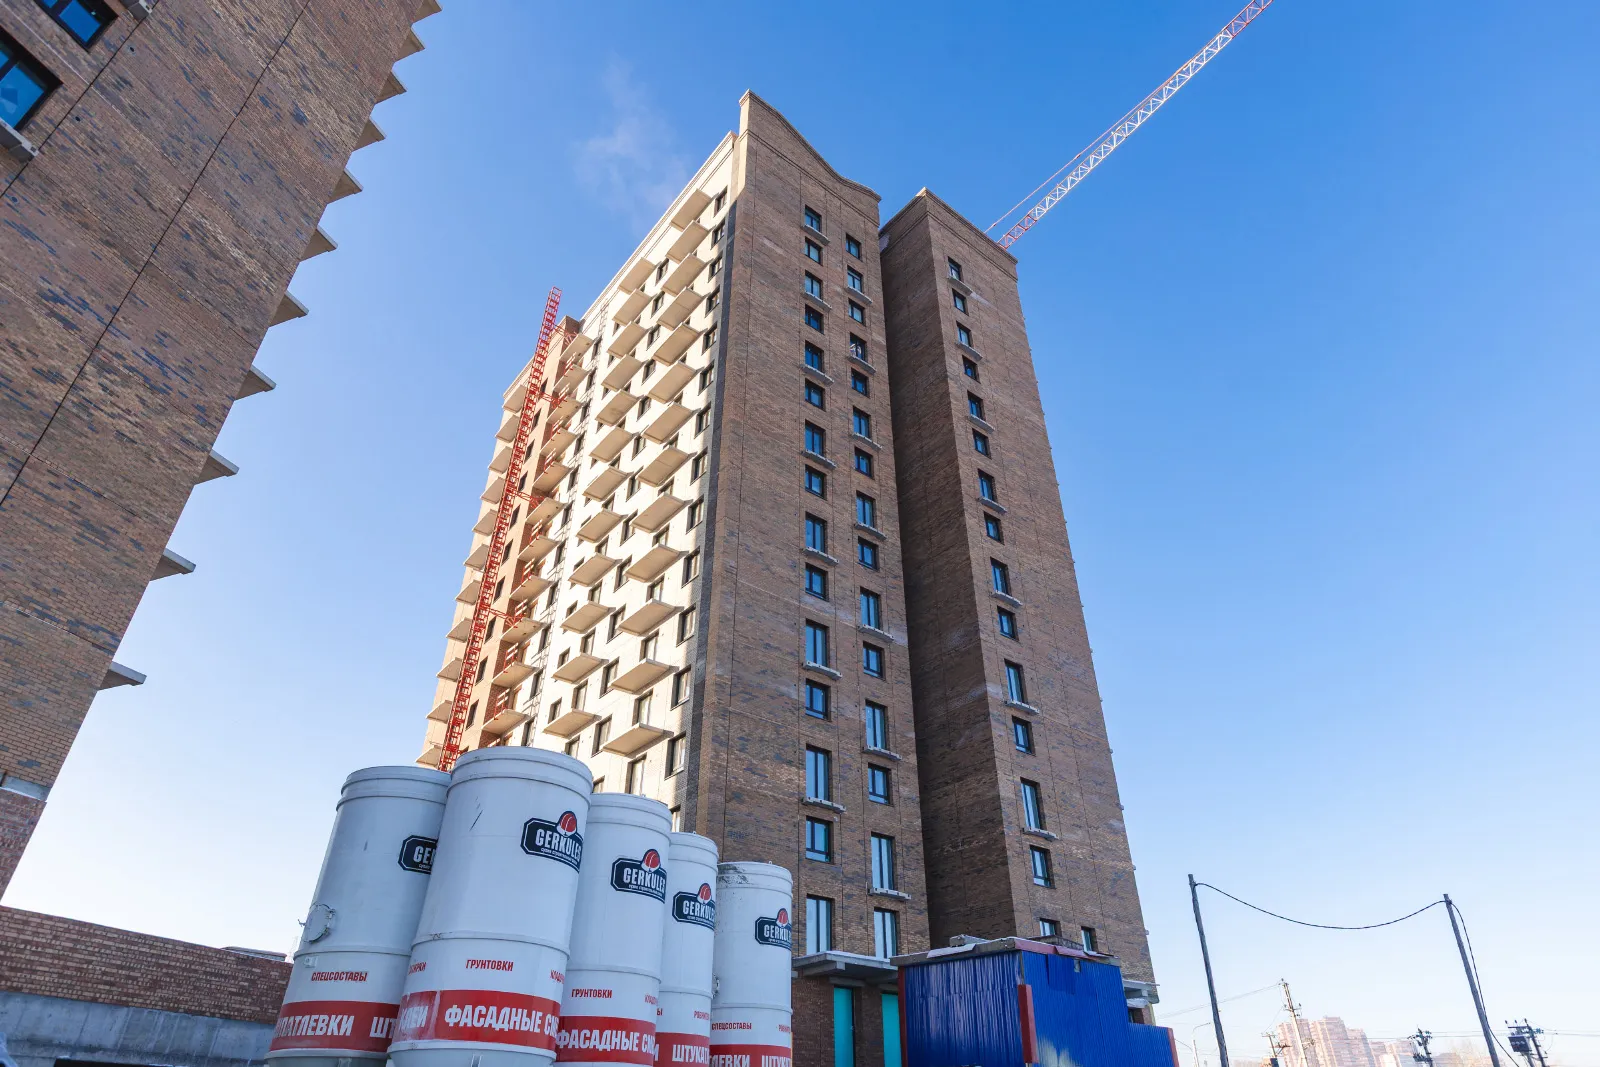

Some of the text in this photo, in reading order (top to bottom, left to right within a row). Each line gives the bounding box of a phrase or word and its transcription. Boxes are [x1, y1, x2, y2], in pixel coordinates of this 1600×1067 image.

[535, 829, 581, 862] GERKULES
[465, 959, 514, 972] ГРУНТОВКИ
[311, 971, 368, 982] СПЕЦСОСТАВЫ
[571, 988, 613, 998] ГРУНТОВКИ
[444, 1004, 543, 1034] ФАСАДНЫЕ
[711, 1022, 752, 1031] СПЕЦСОСТАВЫ
[556, 1029, 640, 1052] ФАСАДНЫЕ
